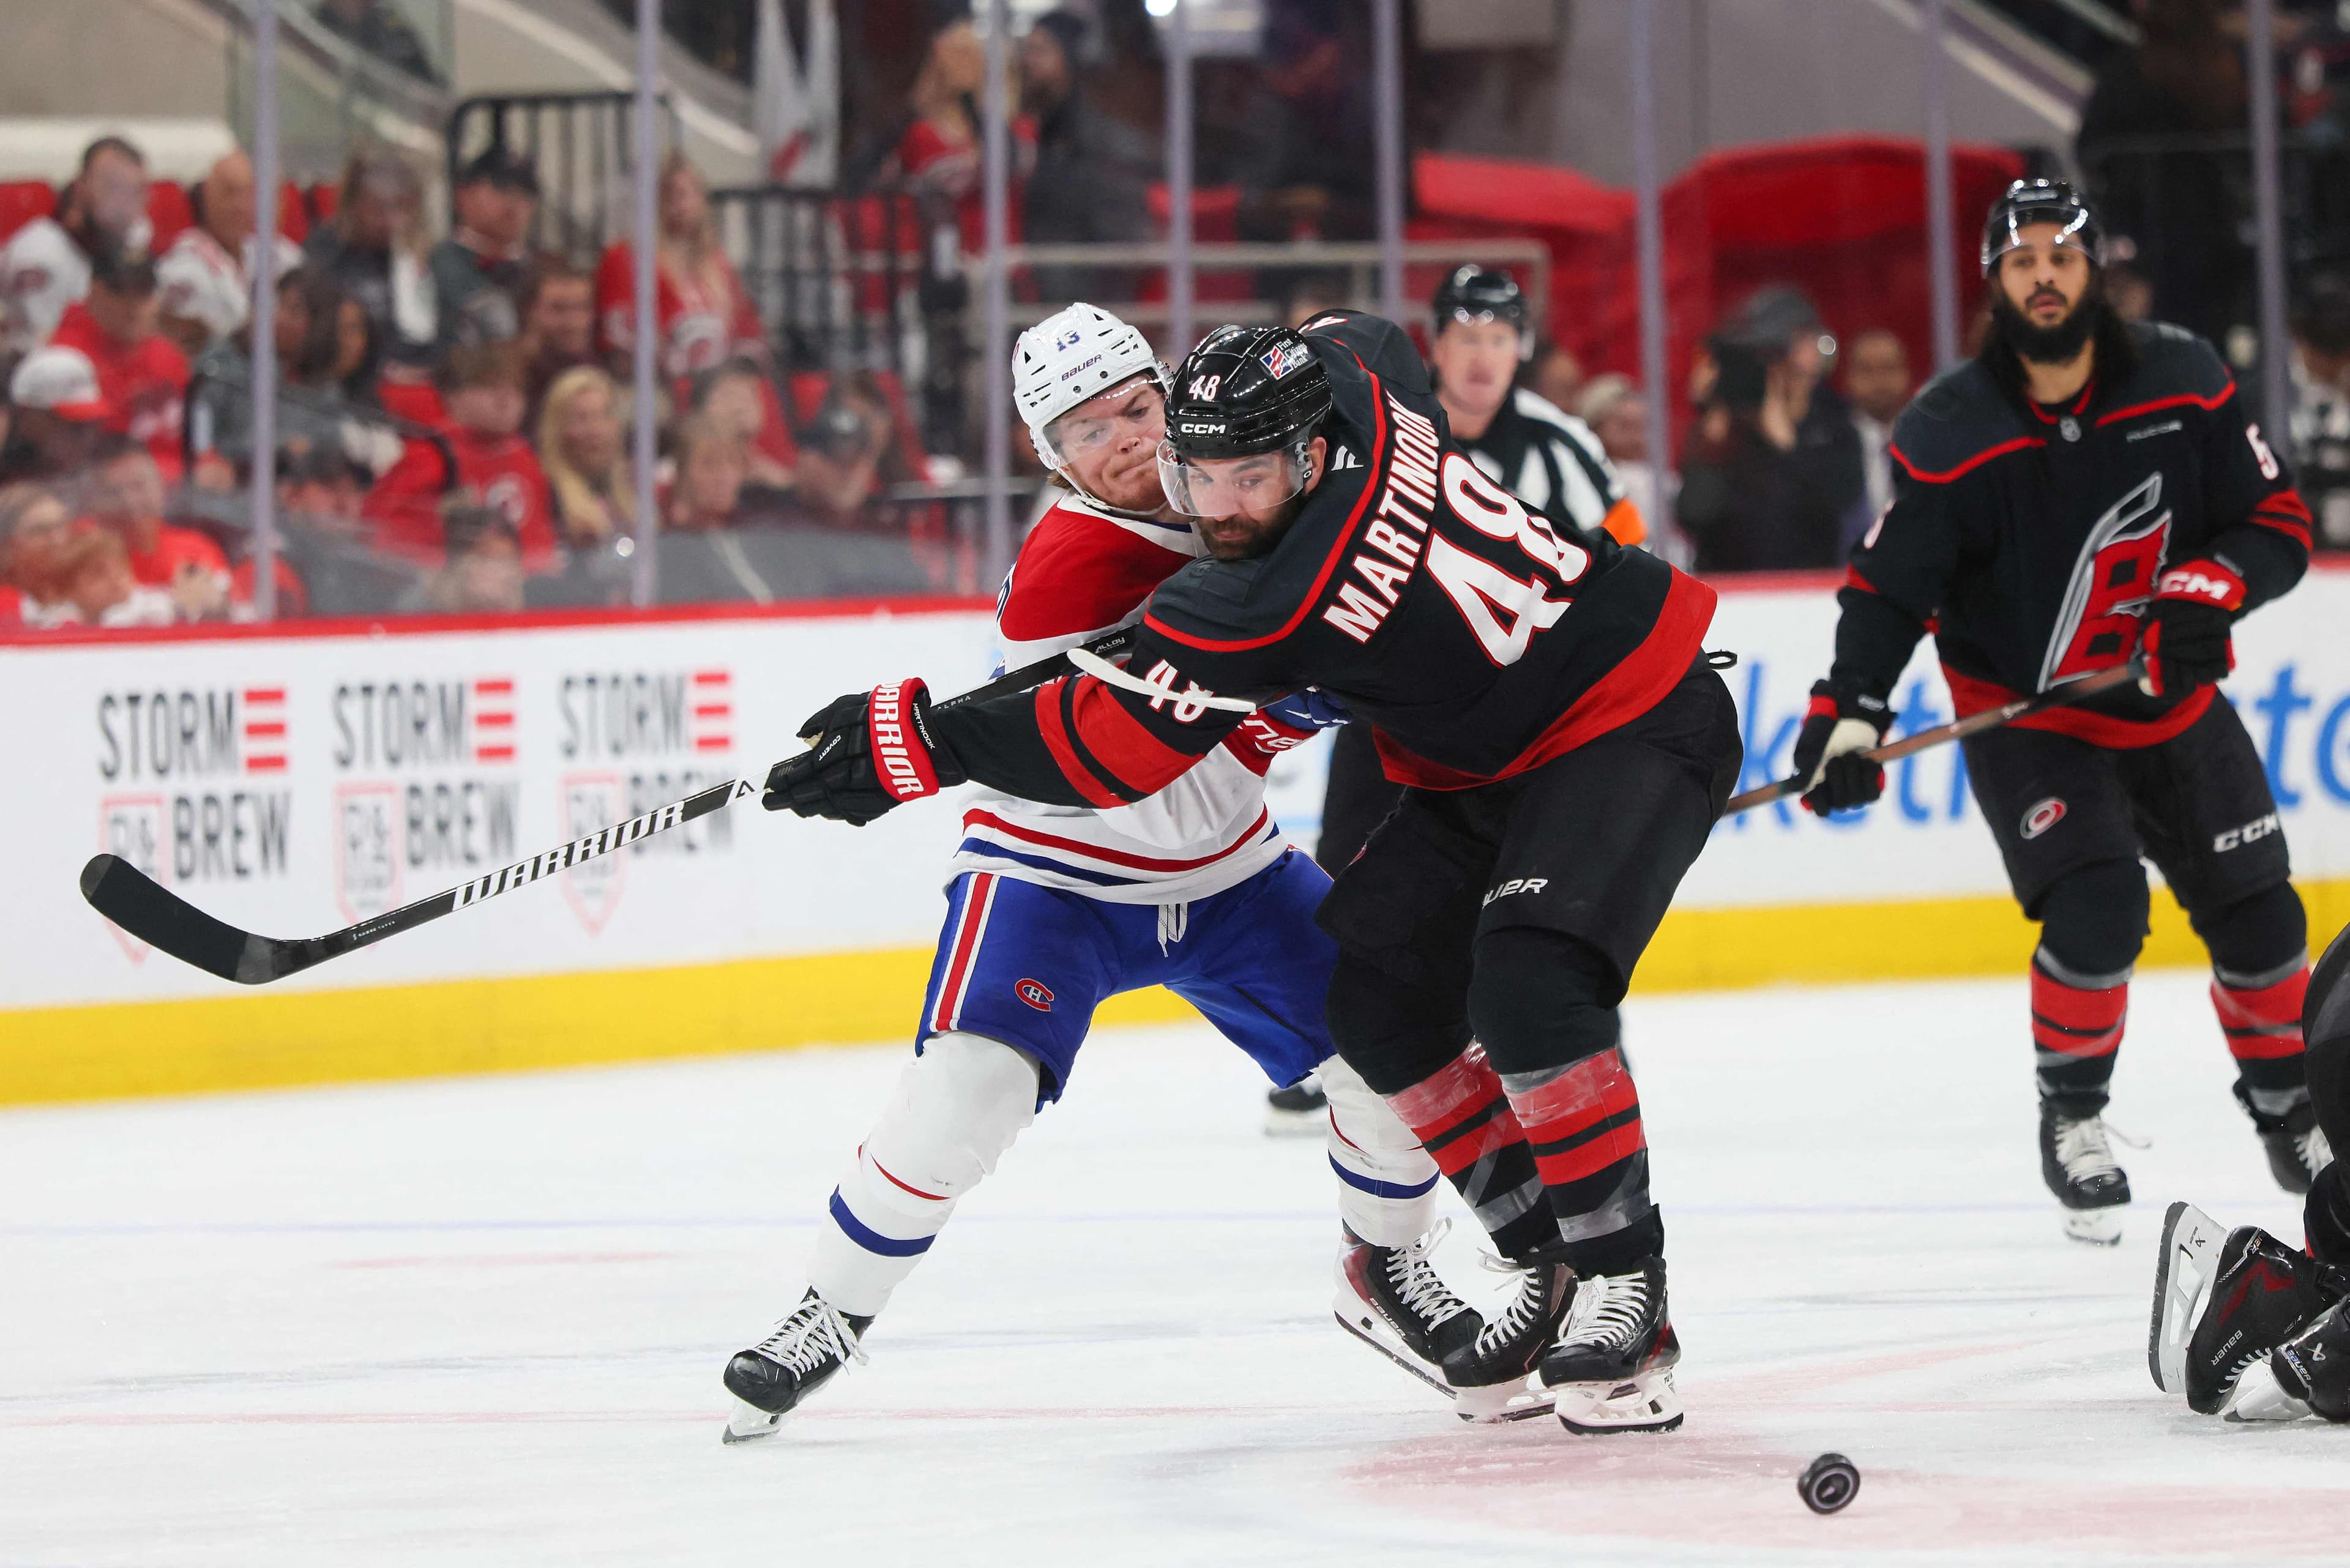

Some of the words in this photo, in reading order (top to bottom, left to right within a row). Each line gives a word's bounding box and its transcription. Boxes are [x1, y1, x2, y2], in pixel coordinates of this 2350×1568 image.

[1056, 330, 1081, 353] 13
[1275, 338, 1293, 351] First
[1285, 343, 1308, 360] Citizens
[1061, 354, 1102, 382] BAUER
[1291, 354, 1308, 368] Bank
[1188, 375, 1221, 401] 48
[1181, 424, 1226, 435] CCM
[1322, 387, 1439, 643] MARTINOOK
[1424, 452, 1592, 669] 48
[2160, 570, 2231, 600] CM
[937, 695, 972, 711] ALPHA
[1143, 659, 1215, 724] 48
[334, 679, 469, 769] STORM
[558, 672, 688, 760] STORM
[912, 703, 936, 750] MARTINOOK
[99, 691, 237, 780] STORM
[818, 734, 841, 761] COVERT
[173, 790, 293, 880] BREW
[406, 778, 520, 866] BREW
[452, 801, 686, 912] WARRIOR
[1481, 878, 1548, 909] UER
[1369, 1297, 1406, 1337] BAUER
[2210, 1329, 2243, 1366] BAUER
[2286, 1349, 2312, 1381] BAUER
